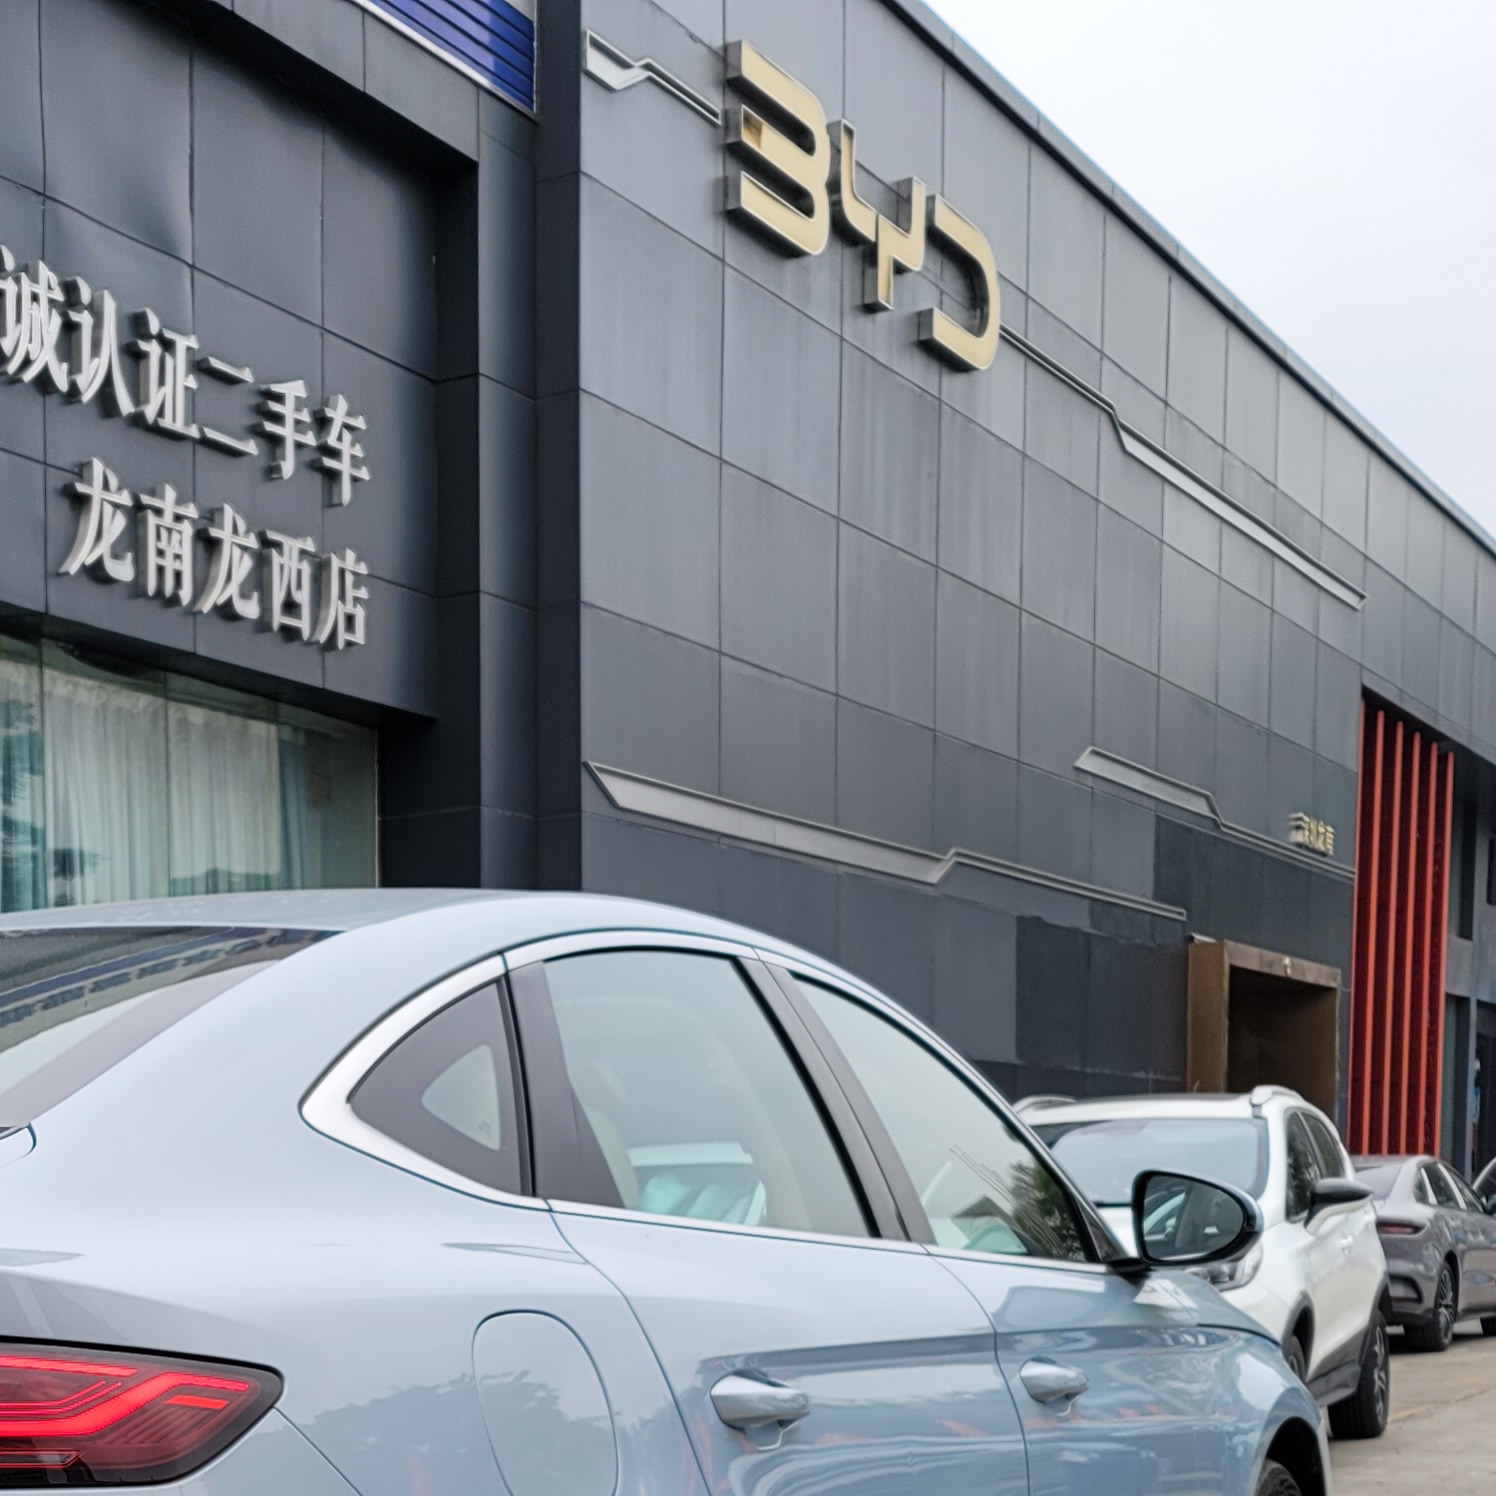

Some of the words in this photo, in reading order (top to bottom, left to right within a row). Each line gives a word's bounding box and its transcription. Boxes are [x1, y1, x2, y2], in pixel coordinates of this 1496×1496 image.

[724, 39, 1000, 371] BYD
[58, 457, 370, 651] 龙南龙西店
